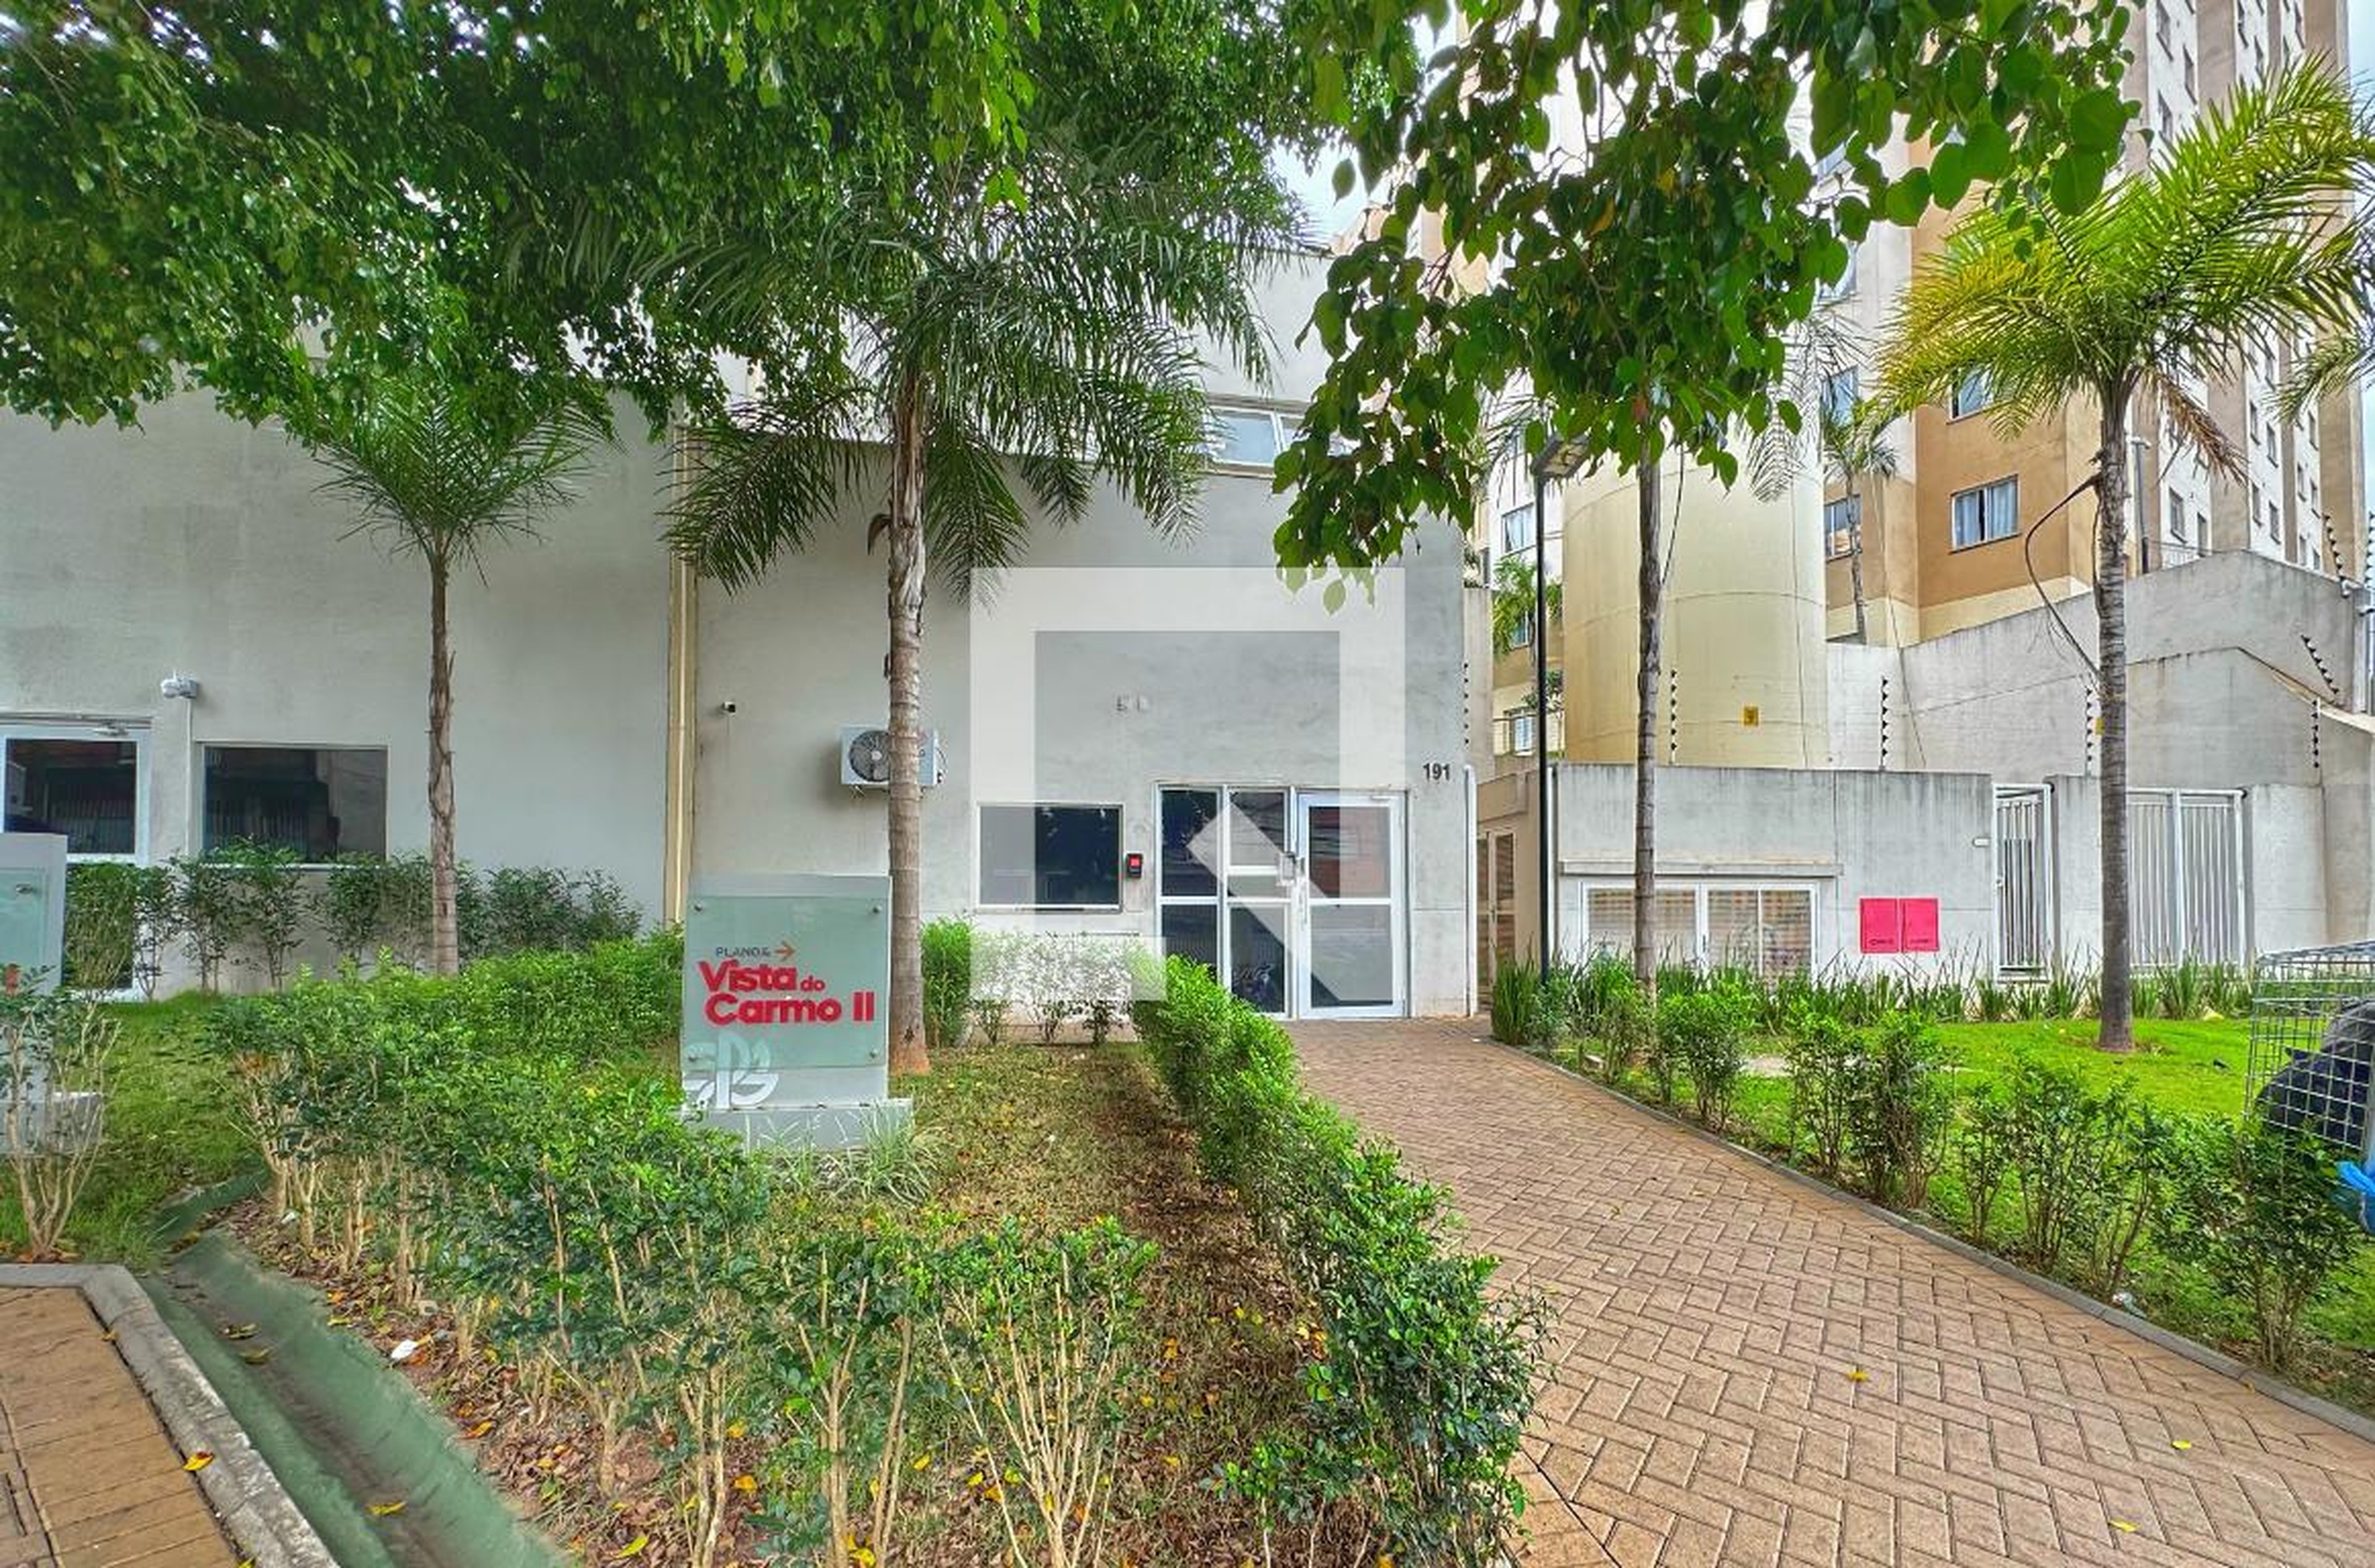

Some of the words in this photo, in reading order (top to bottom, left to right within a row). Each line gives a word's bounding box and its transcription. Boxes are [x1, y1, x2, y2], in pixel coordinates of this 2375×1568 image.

[1423, 762, 1450, 781] 191
[698, 959, 797, 992] Vista
[800, 975, 825, 991] do
[704, 992, 842, 1025] Carmo
[853, 992, 875, 1021] II
